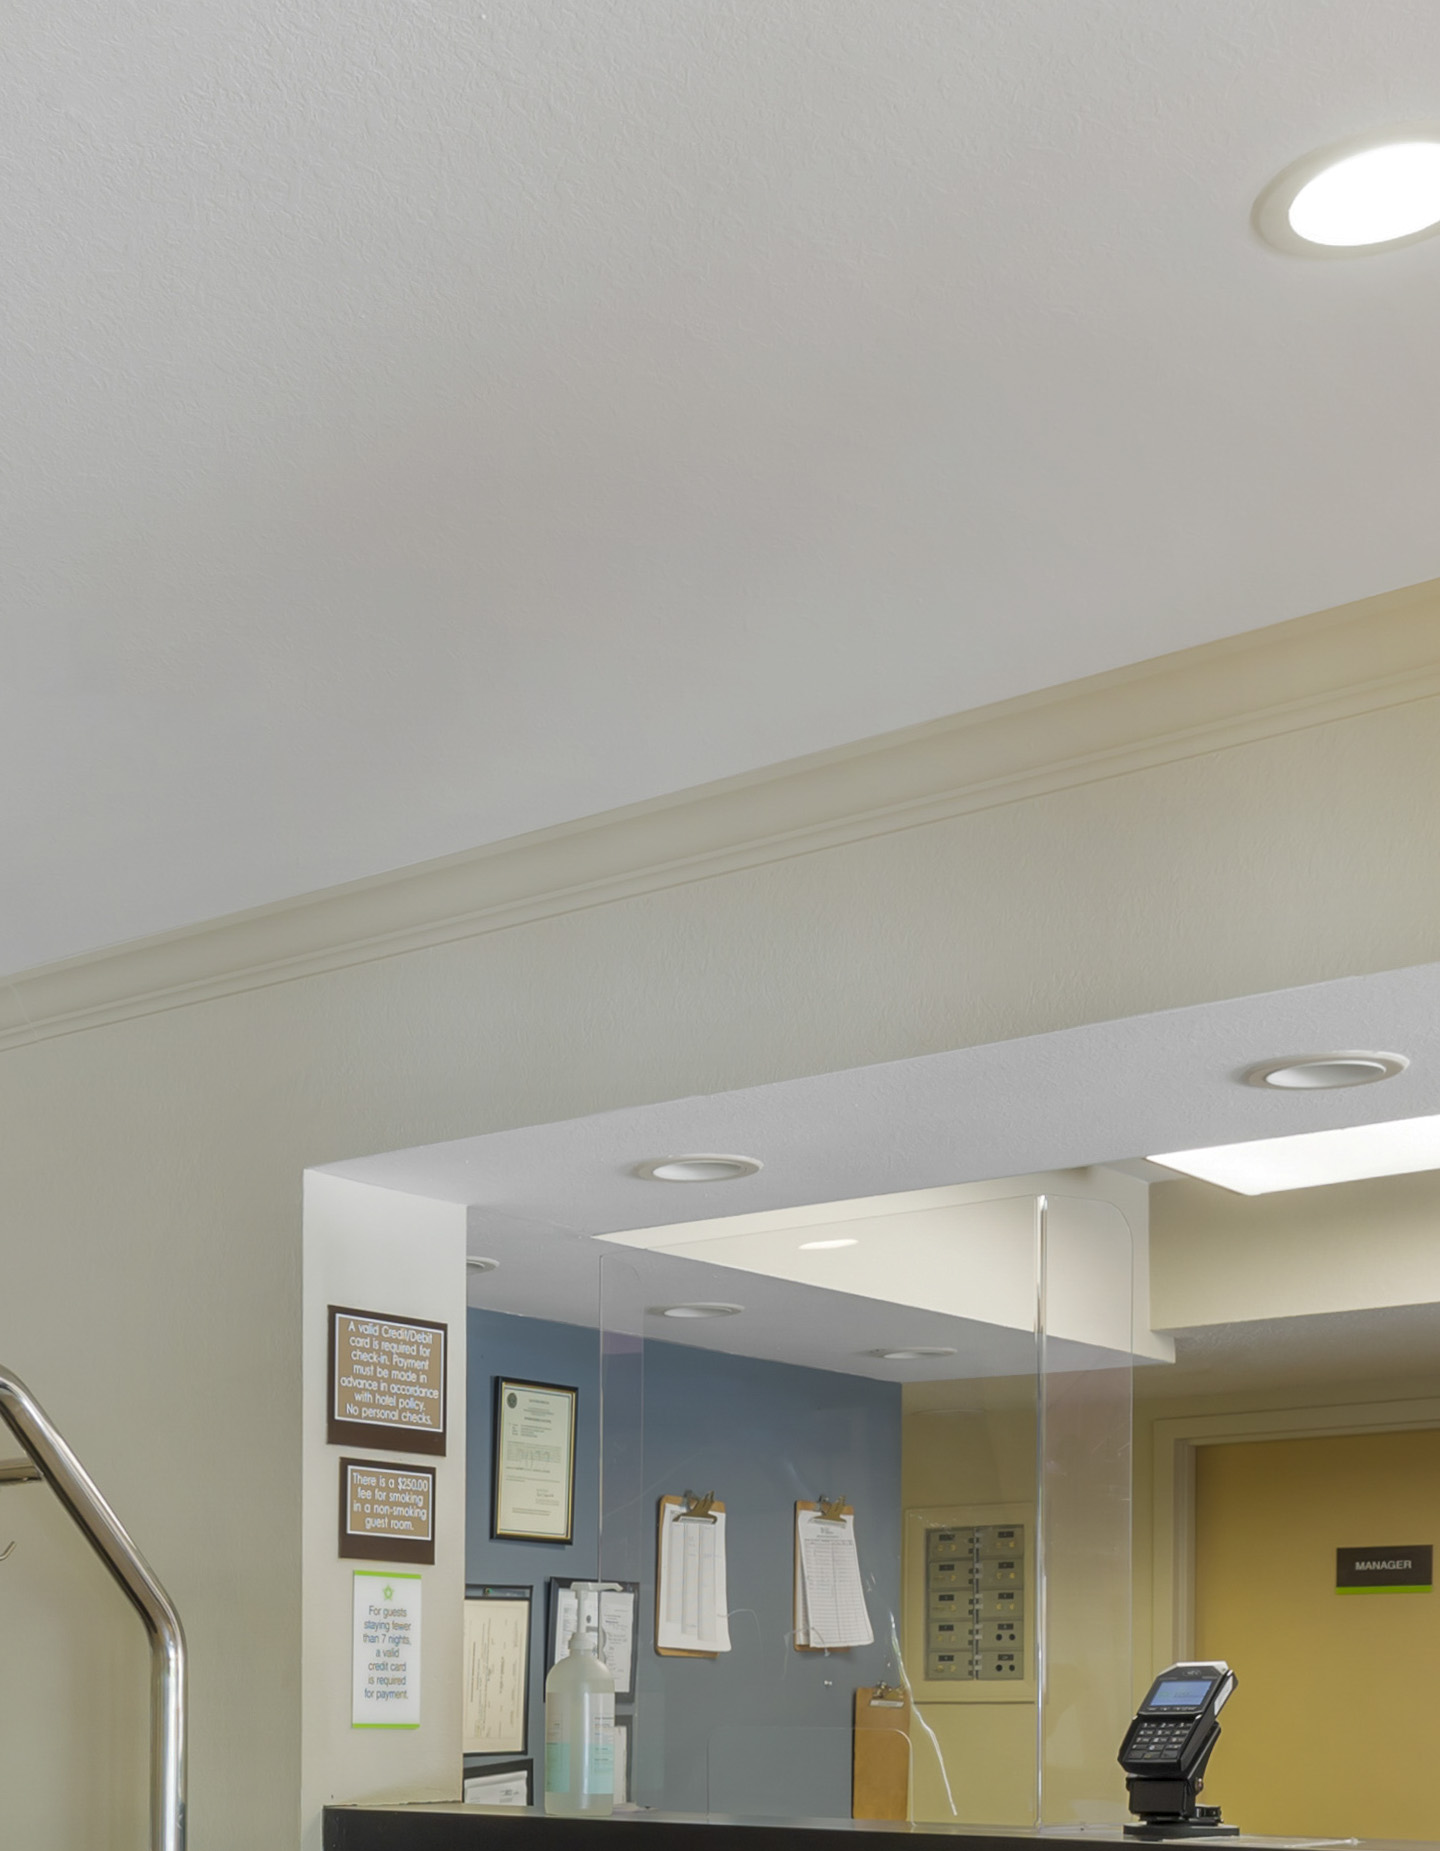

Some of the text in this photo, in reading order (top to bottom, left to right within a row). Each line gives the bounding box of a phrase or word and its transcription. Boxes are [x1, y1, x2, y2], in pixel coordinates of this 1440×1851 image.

[348, 1321, 433, 1344] A valid Credit/Debit
[349, 1336, 431, 1357] card is required for
[351, 1349, 429, 1370] check-in. Payment
[353, 1364, 427, 1383] must be made in
[340, 1376, 439, 1399] advance in accordance
[354, 1391, 426, 1412] with hotel policy.
[346, 1403, 432, 1425] No personal checks.
[353, 1472, 428, 1491] There is a $250.00
[357, 1487, 423, 1507] fee for smoking
[353, 1500, 427, 1521] in a non-smoking
[365, 1517, 414, 1530] guest room.
[1355, 1560, 1412, 1571] MANAGER
[369, 1605, 407, 1619] For guests
[364, 1620, 411, 1633] staying fewer
[363, 1633, 411, 1647] than 7 nights,
[376, 1648, 400, 1658] a valid
[368, 1661, 406, 1672] credit card
[368, 1676, 406, 1687] is required
[364, 1688, 408, 1701] for payment.
